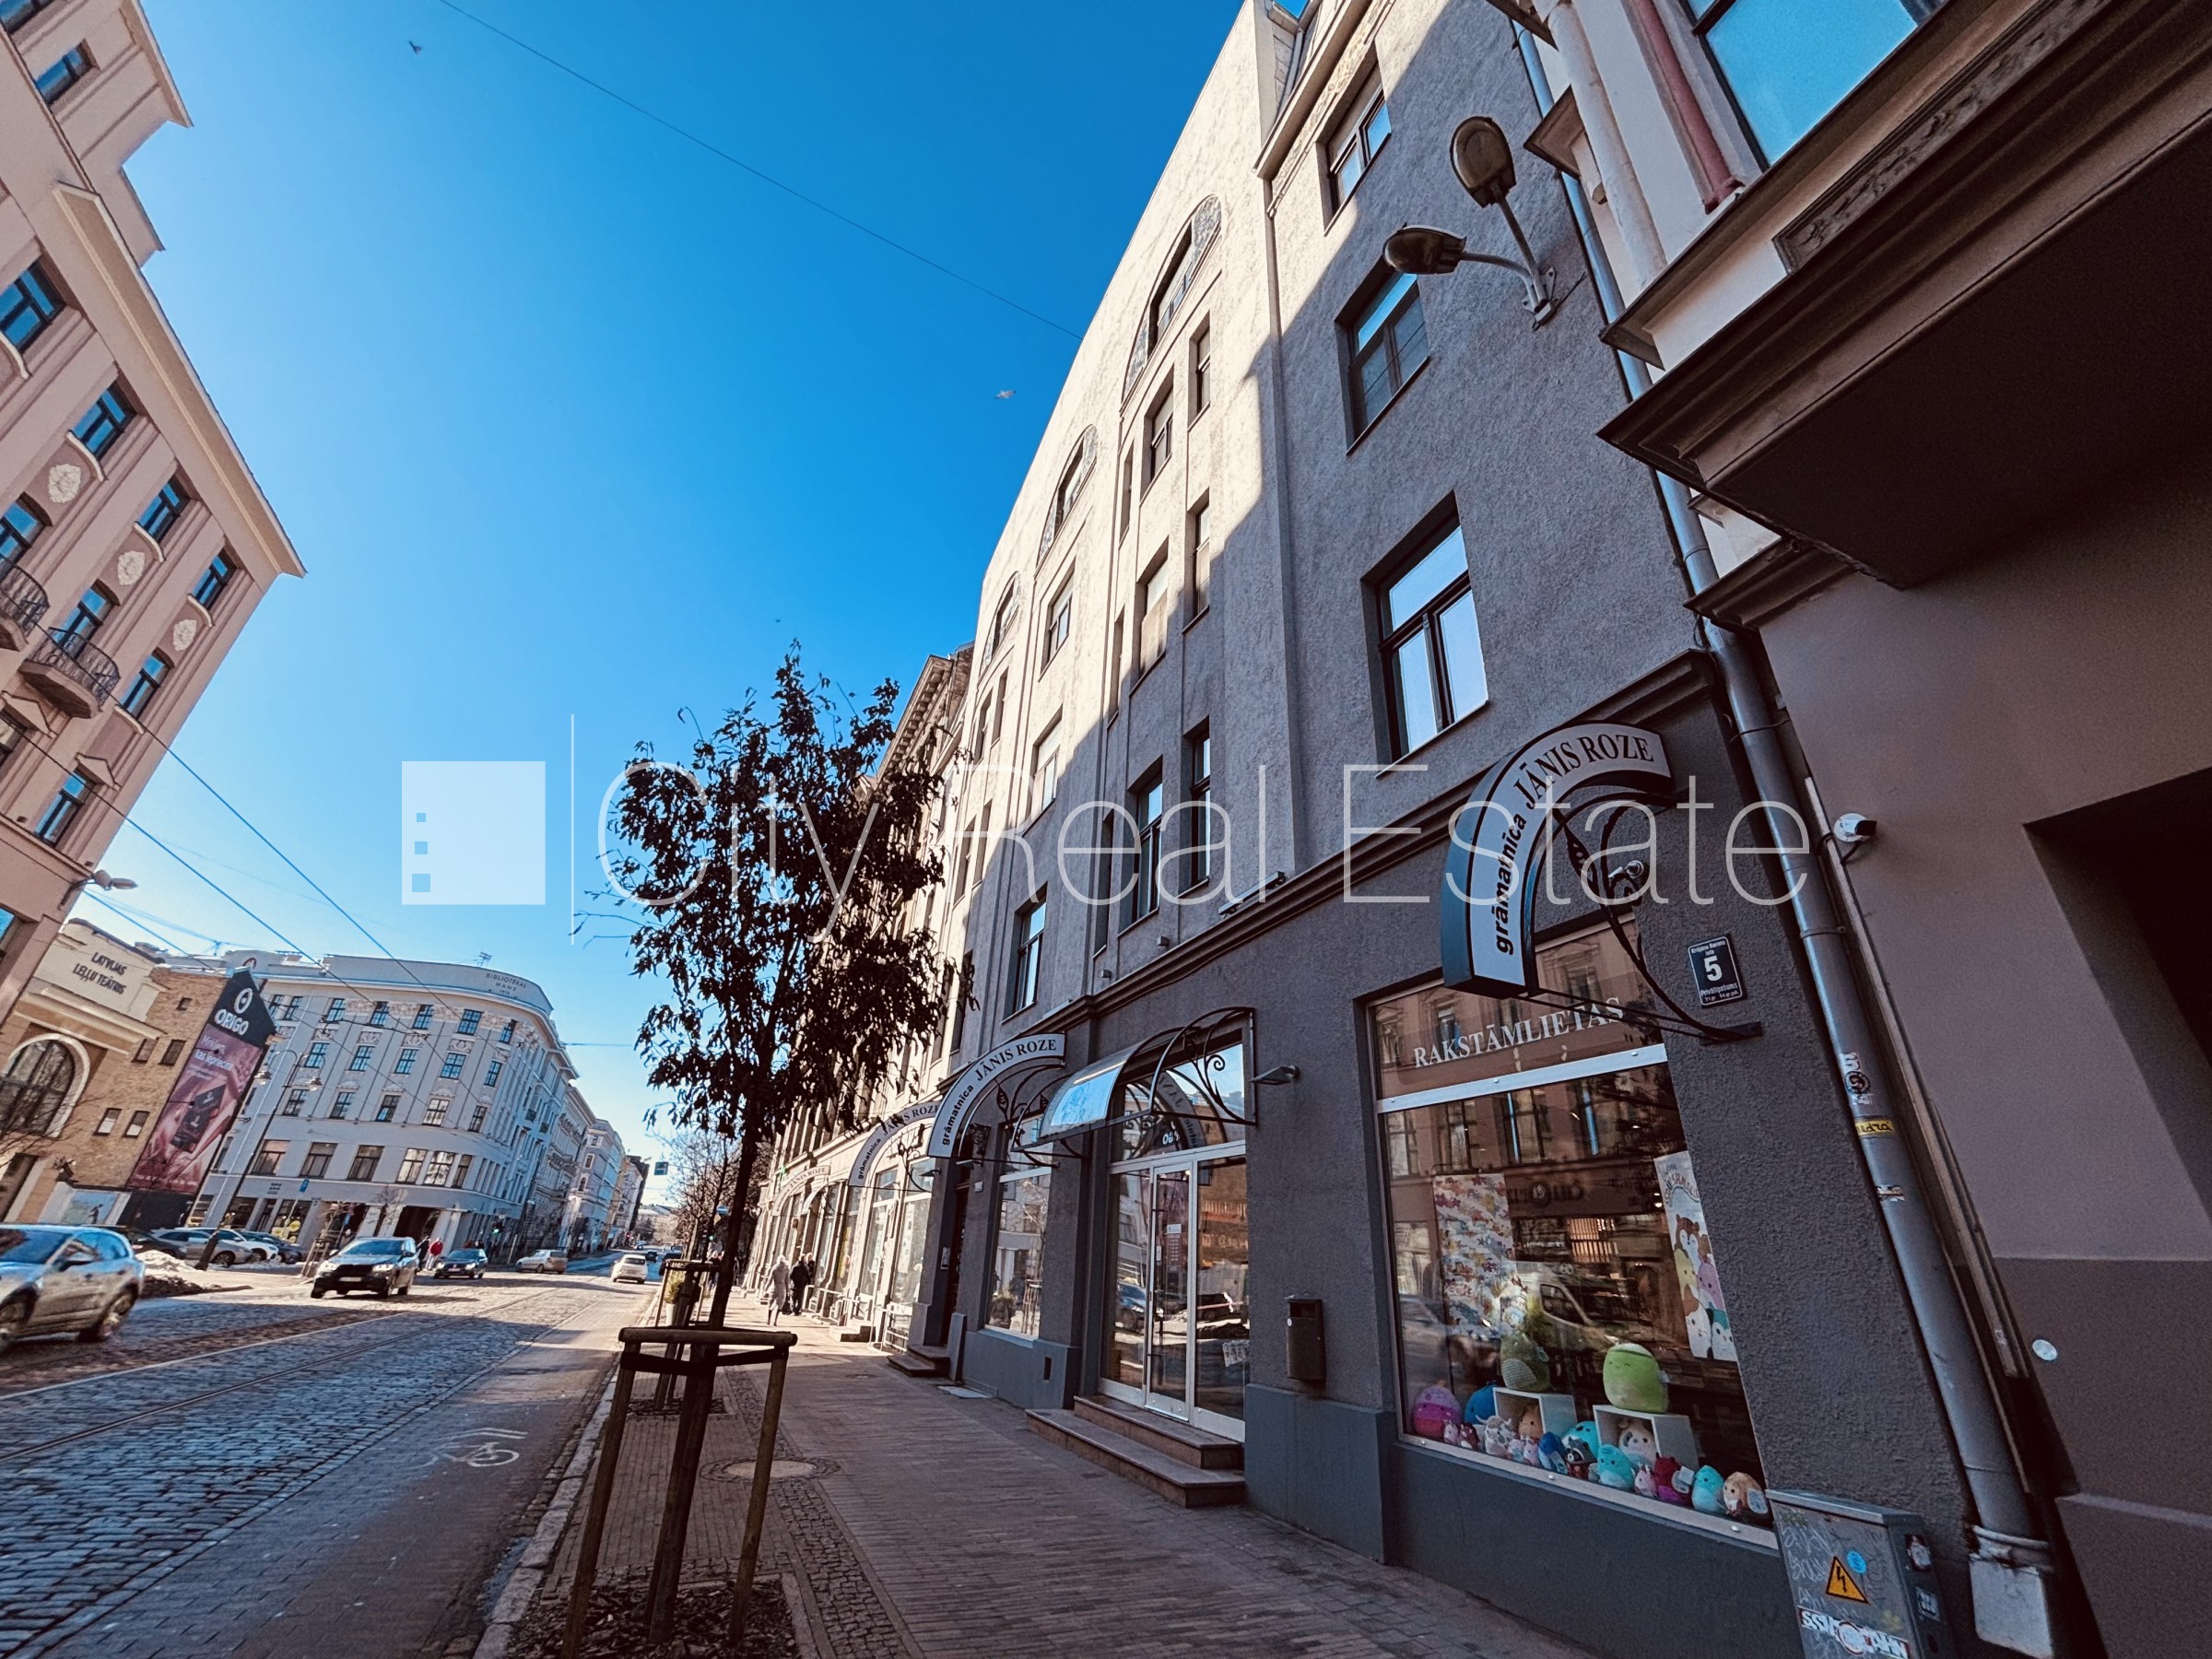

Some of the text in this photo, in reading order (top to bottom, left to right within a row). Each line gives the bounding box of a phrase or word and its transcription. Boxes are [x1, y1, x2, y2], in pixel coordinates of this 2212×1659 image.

[1490, 734, 1655, 955] grāmatnica JĀNIS ROZE
[90, 951, 128, 976] LATVIJAS
[1703, 955, 1723, 982] 5
[96, 973, 126, 994] TEĀTRIS
[214, 1008, 250, 1036] ORIGO
[1414, 996, 1625, 1069] RAKSTĀMLIETAS
[941, 1039, 1057, 1147] grāmatnica JĀNIS ROZE
[857, 1137, 882, 1180] grāmatnica
